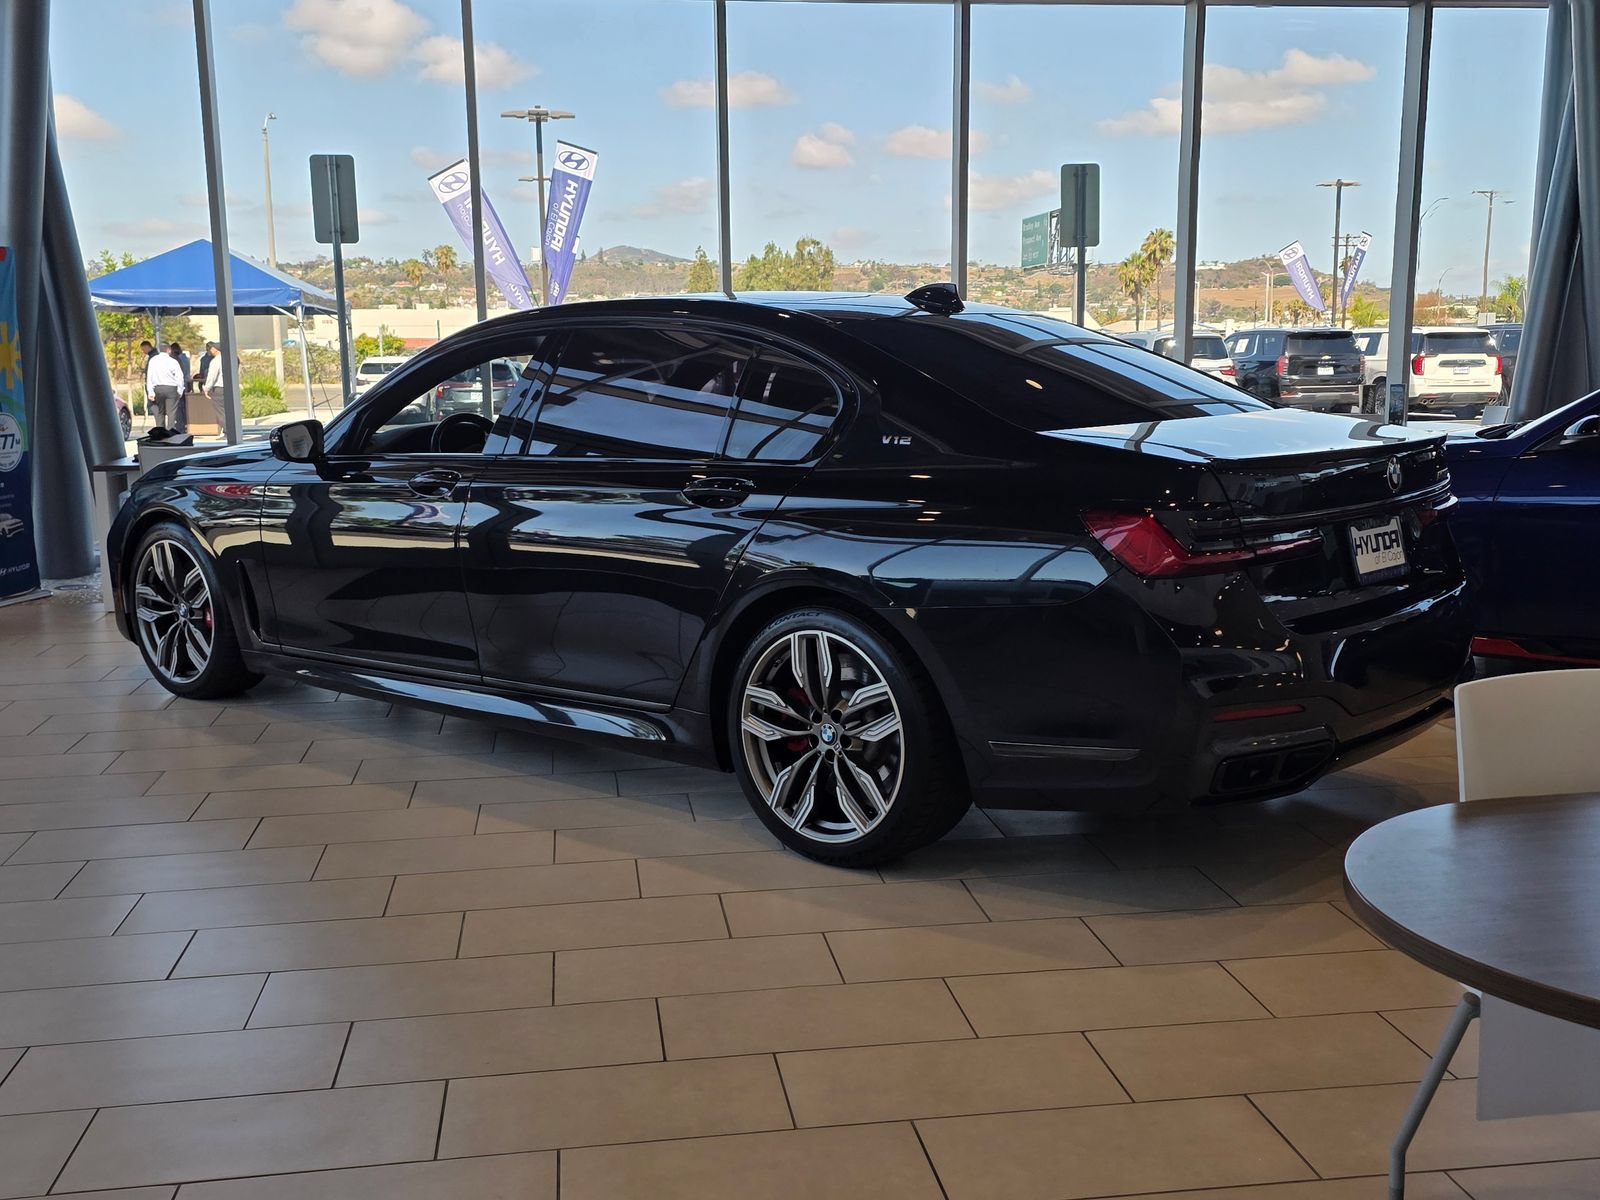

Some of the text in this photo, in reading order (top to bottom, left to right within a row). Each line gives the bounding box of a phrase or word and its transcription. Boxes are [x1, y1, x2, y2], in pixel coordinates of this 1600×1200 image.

[551, 179, 579, 252] HYUNDAI
[544, 222, 555, 246] Cajon
[882, 435, 912, 445] V12
